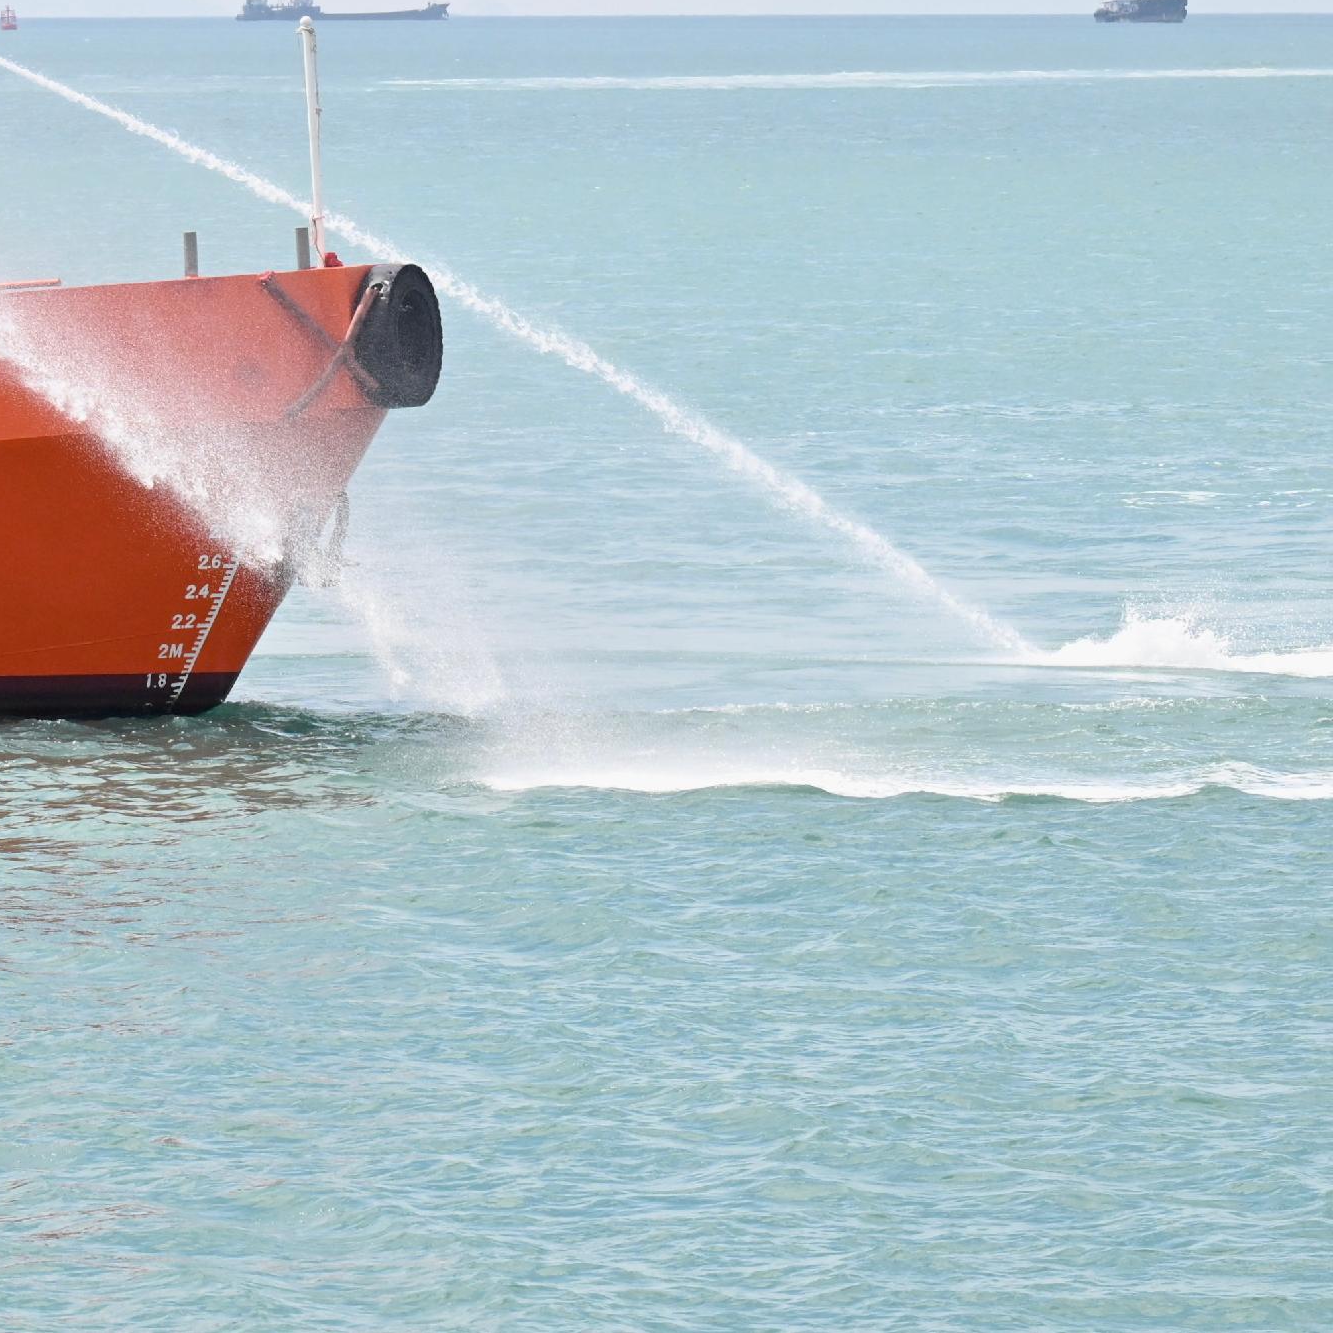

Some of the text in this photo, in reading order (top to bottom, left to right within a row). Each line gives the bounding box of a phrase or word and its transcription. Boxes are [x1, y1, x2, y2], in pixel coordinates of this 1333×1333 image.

[198, 554, 222, 570] 2.6
[185, 584, 210, 599] 2.4
[171, 614, 197, 629] 2.2
[158, 643, 183, 658] 2M
[146, 673, 168, 688] 1.8
